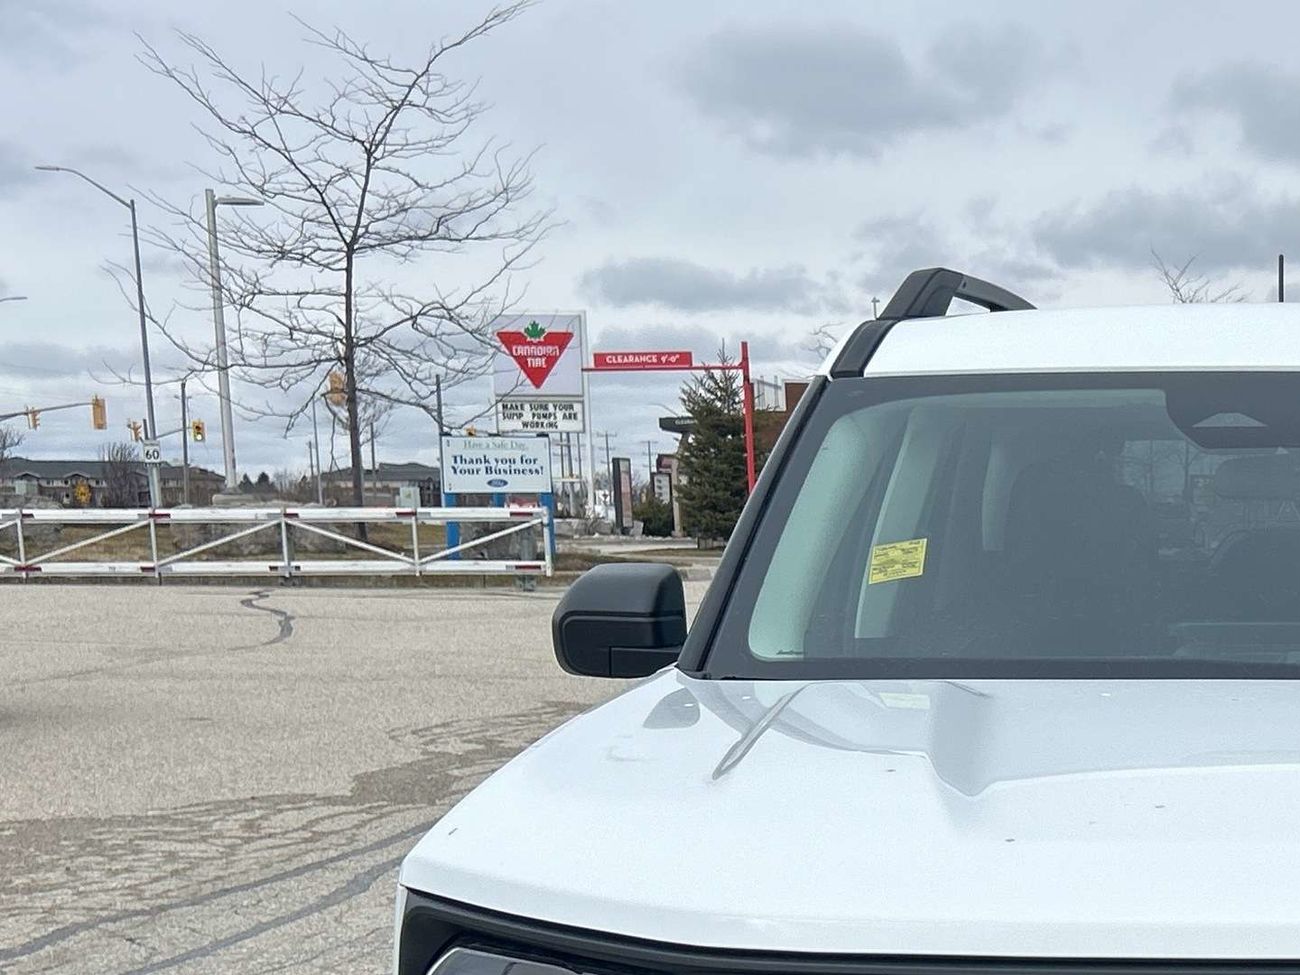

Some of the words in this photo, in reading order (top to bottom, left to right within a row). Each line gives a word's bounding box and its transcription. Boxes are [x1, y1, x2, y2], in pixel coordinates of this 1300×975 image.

[513, 345, 560, 356] CANADIAN
[527, 357, 547, 368] TIRE
[606, 355, 658, 364] CLEARANCE
[502, 403, 525, 411] MAKE
[529, 403, 549, 411] SURE
[552, 403, 575, 411] YOUR
[502, 412, 524, 420] SUMP
[532, 412, 557, 420] PUMPS
[562, 412, 578, 420] ARE
[522, 421, 558, 429] WORKING
[146, 450, 160, 460] 60
[452, 455, 490, 465] Thank
[493, 456, 516, 469] you
[520, 455, 538, 465] for
[451, 466, 481, 475] Your
[485, 466, 544, 475] Business!
